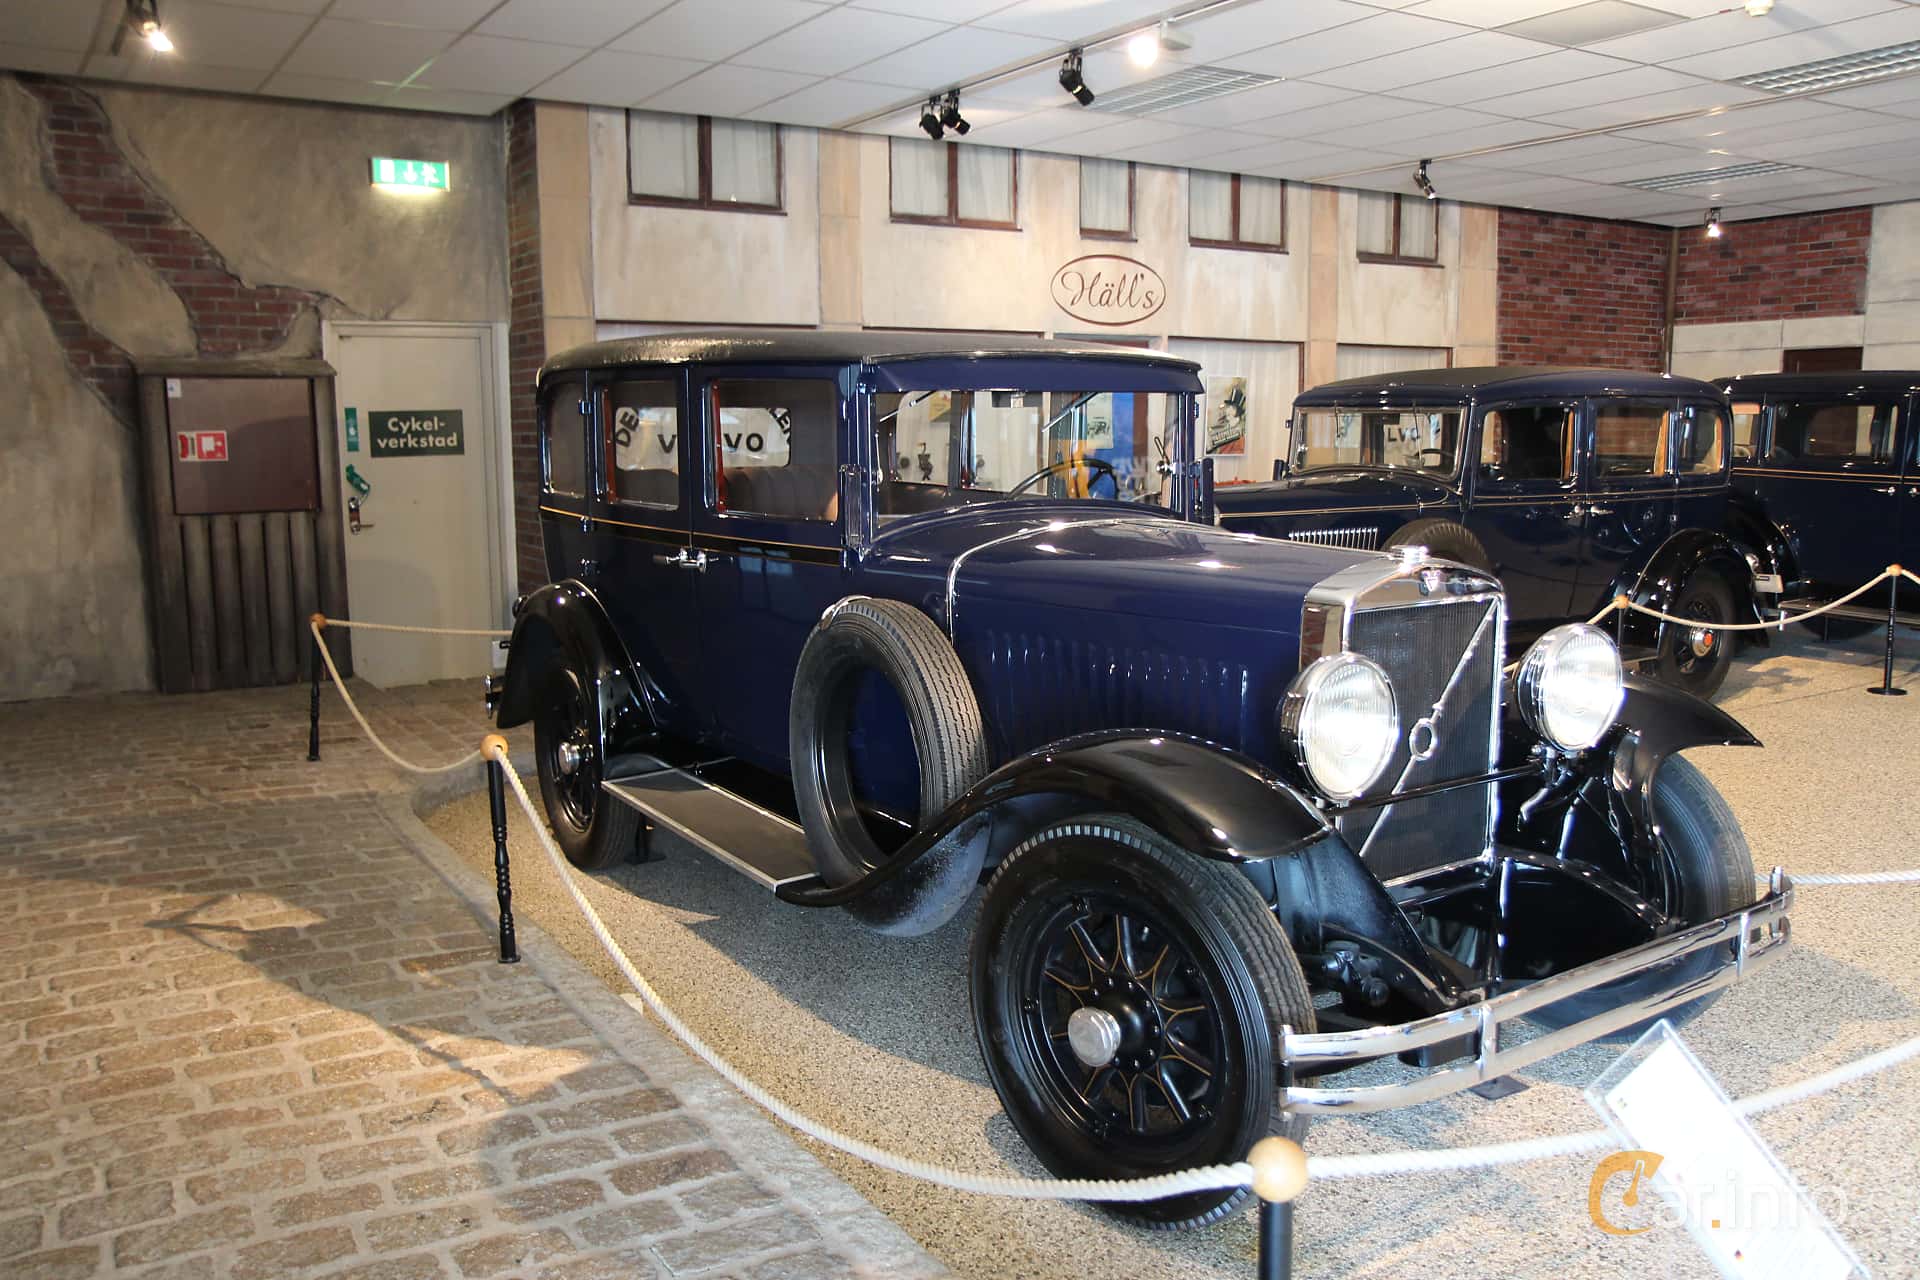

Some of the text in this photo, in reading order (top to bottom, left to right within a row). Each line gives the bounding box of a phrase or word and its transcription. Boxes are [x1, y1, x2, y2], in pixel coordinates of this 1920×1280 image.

[388, 416, 446, 434] Cykel-
[377, 432, 458, 448] verkstad
[657, 432, 764, 453] VVO
